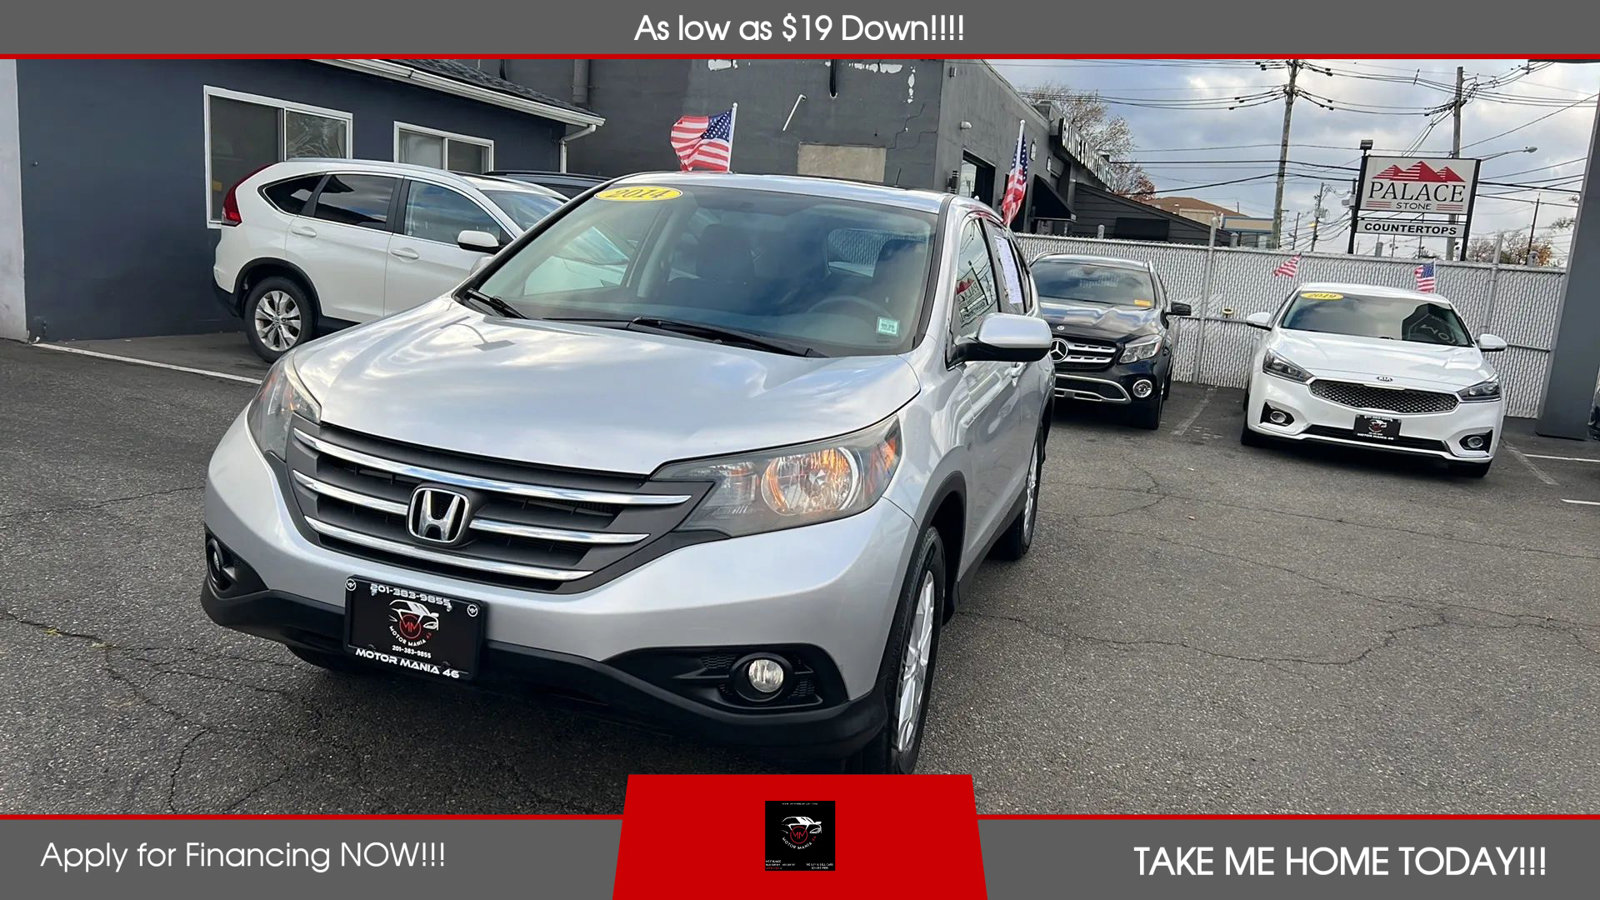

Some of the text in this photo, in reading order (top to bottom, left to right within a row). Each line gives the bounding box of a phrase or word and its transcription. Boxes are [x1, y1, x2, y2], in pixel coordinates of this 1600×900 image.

[606, 189, 671, 199] 2014
[1368, 181, 1466, 203] PALACE
[1396, 202, 1432, 210] STONE
[1364, 222, 1457, 235] COUNTERTOPS
[389, 625, 407, 645] MOTOR
[355, 648, 460, 679] MOTOR MANIA 46
